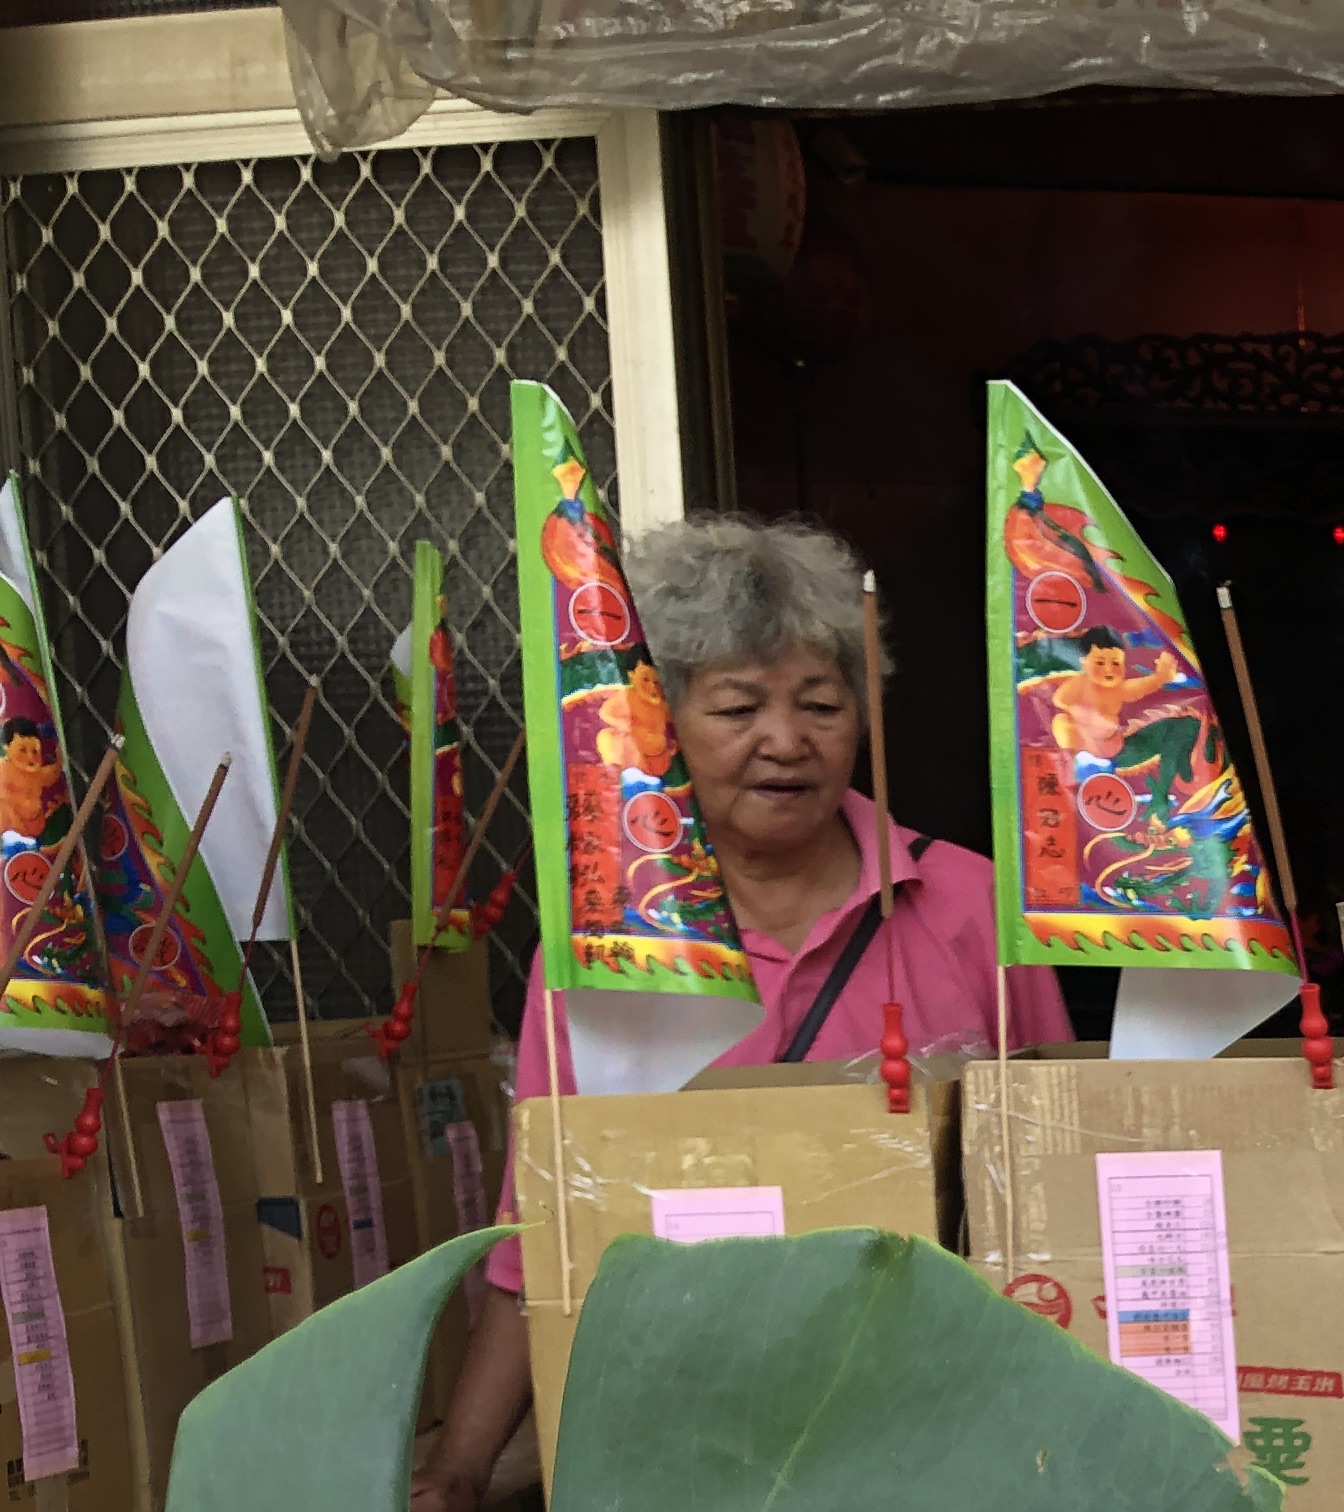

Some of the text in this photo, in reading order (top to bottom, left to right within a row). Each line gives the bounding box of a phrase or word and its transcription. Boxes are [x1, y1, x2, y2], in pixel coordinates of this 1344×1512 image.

[1085, 790, 1127, 817] 心
[1236, 1371, 1336, 1394] 風烤玉米
